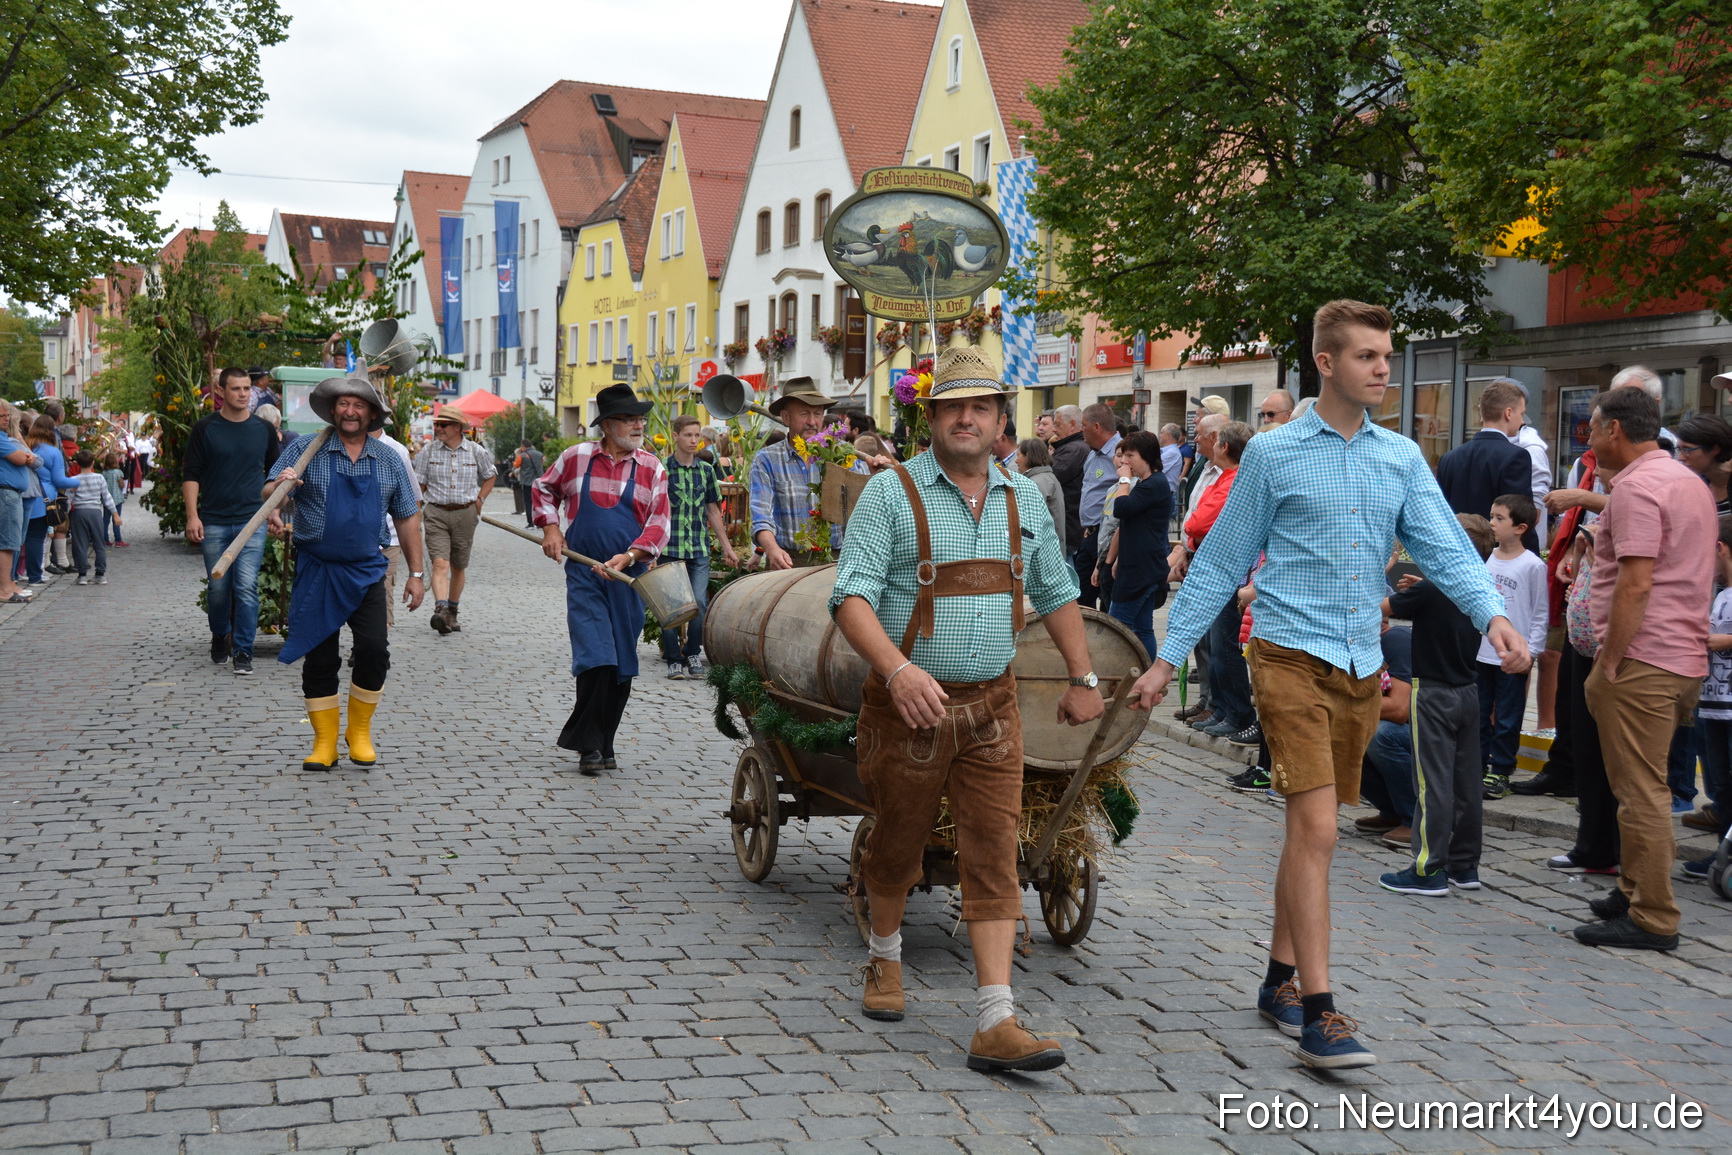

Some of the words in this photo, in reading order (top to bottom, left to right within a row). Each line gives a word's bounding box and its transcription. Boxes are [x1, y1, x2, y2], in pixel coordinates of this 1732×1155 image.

[1515, 223, 1544, 231] ASHIO
[594, 297, 612, 315] HOTEL
[1495, 574, 1518, 590] SPEED
